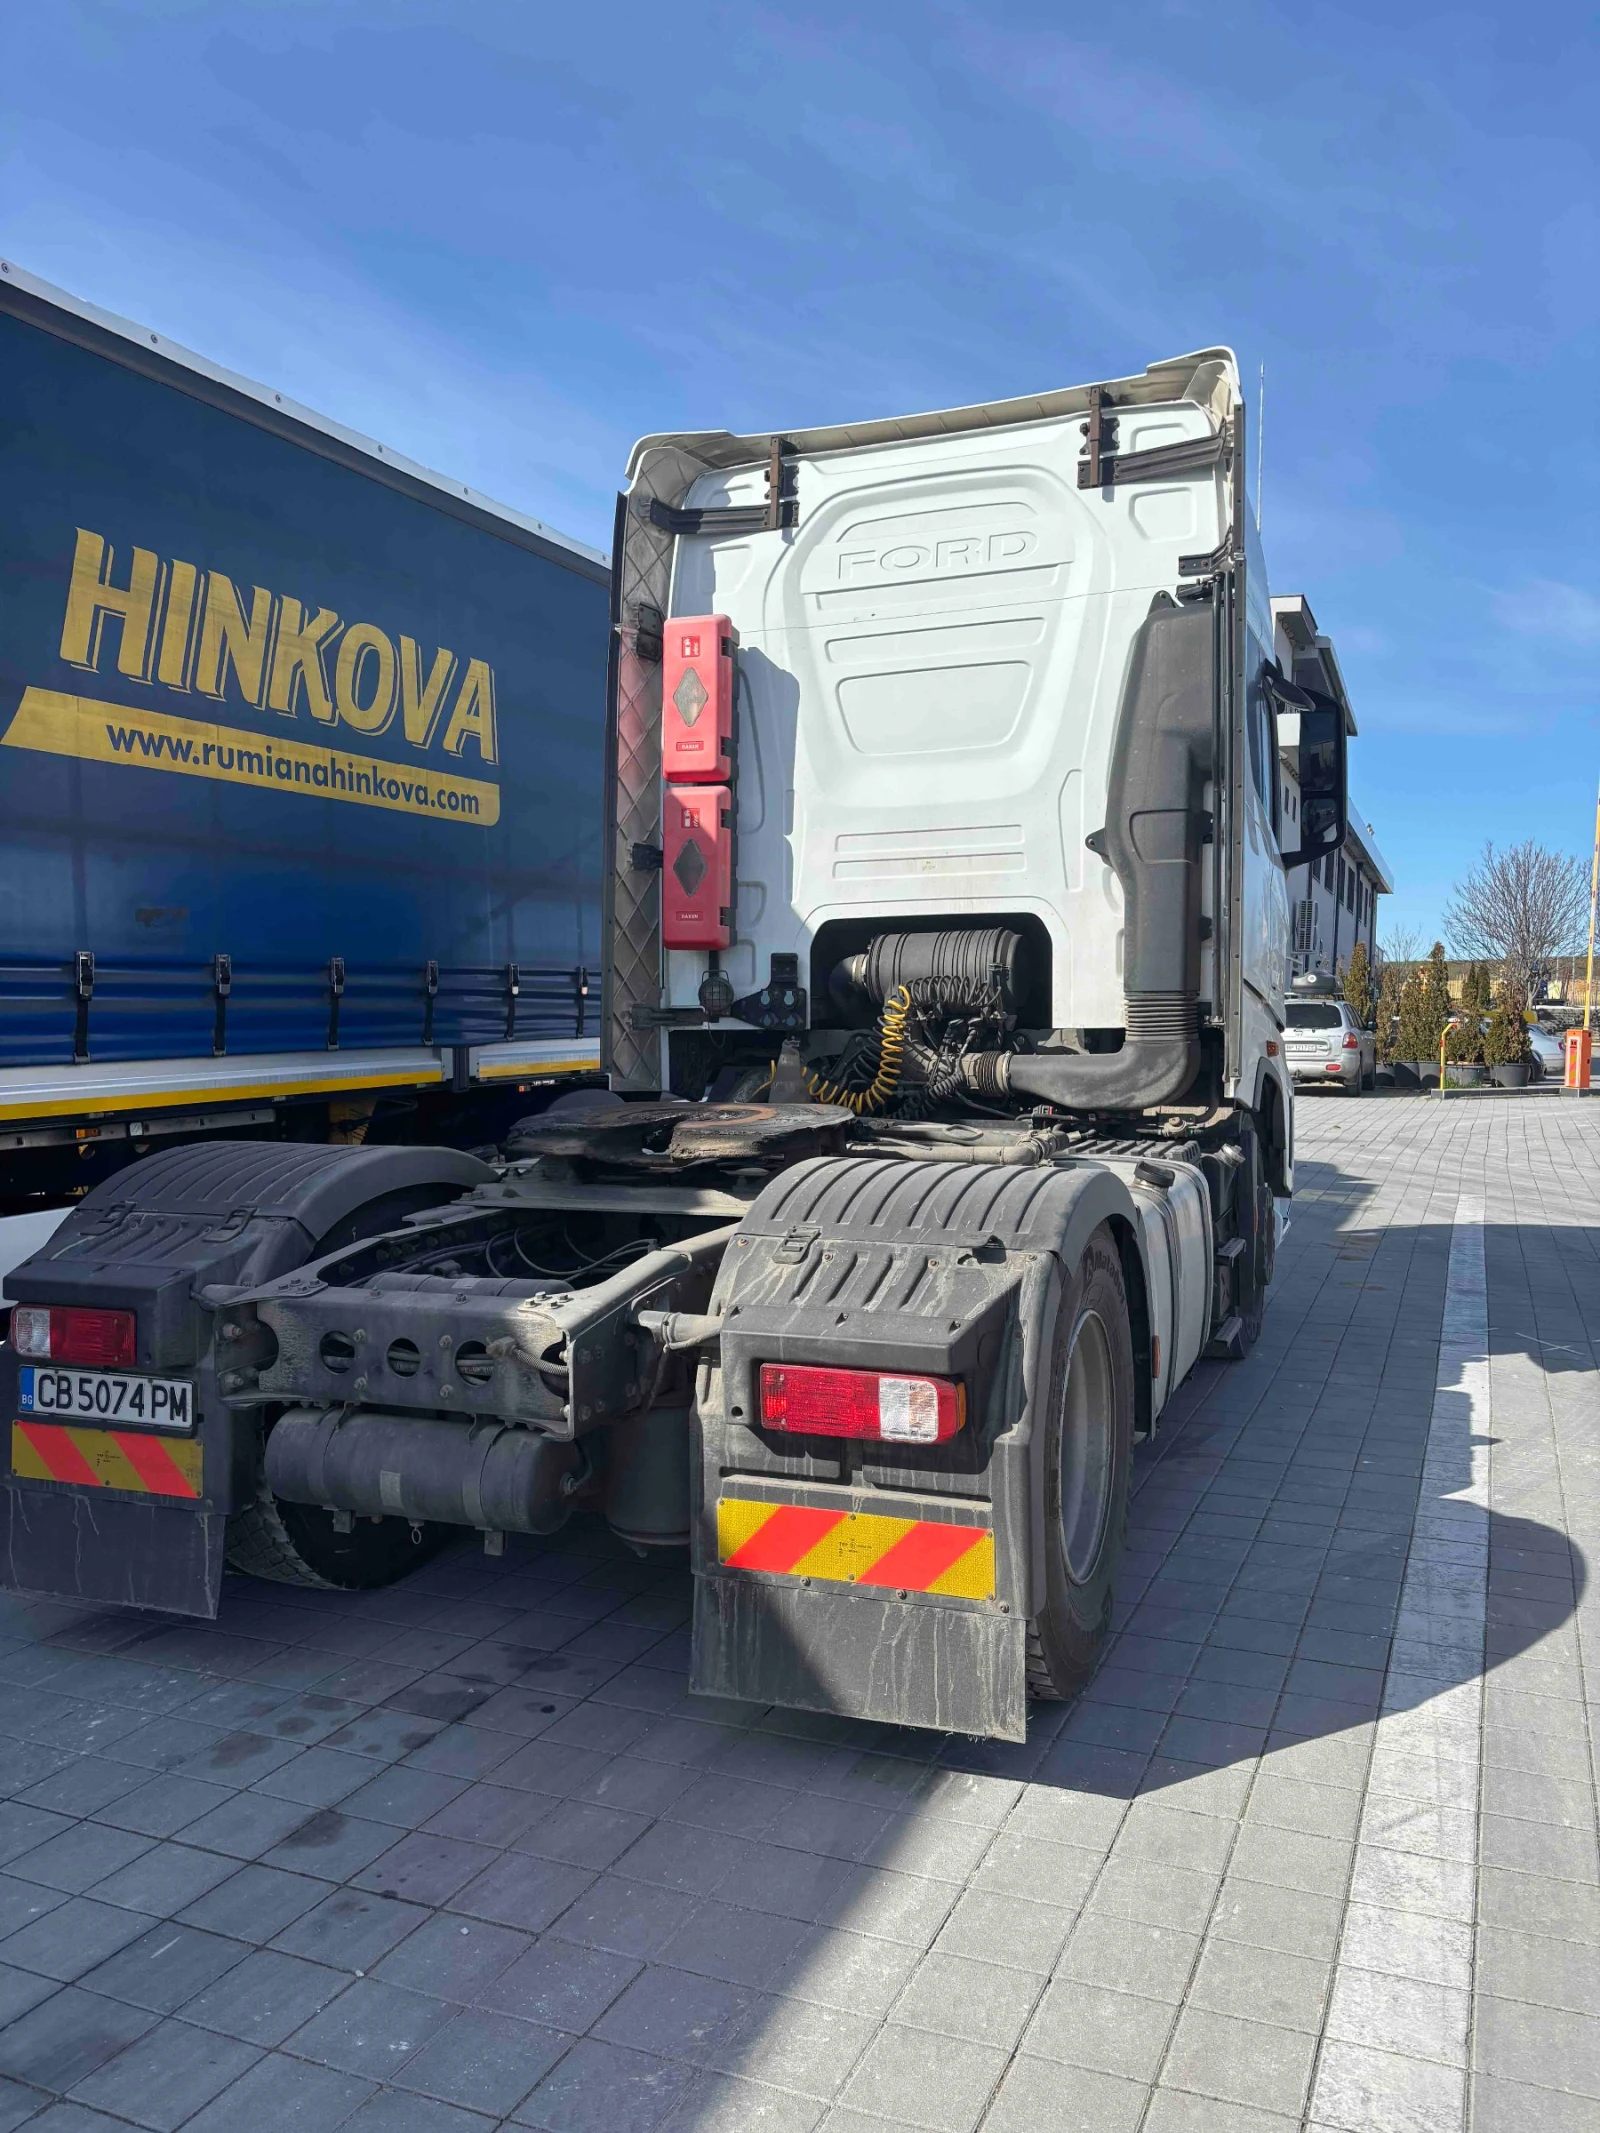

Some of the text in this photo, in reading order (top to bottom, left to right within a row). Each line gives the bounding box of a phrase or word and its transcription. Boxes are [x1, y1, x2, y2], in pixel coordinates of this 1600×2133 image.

[837, 530, 1038, 580] FORD
[60, 526, 499, 766] HINKOVA
[106, 723, 480, 816] www.rumianahinkova.com
[22, 1394, 33, 1405] BG
